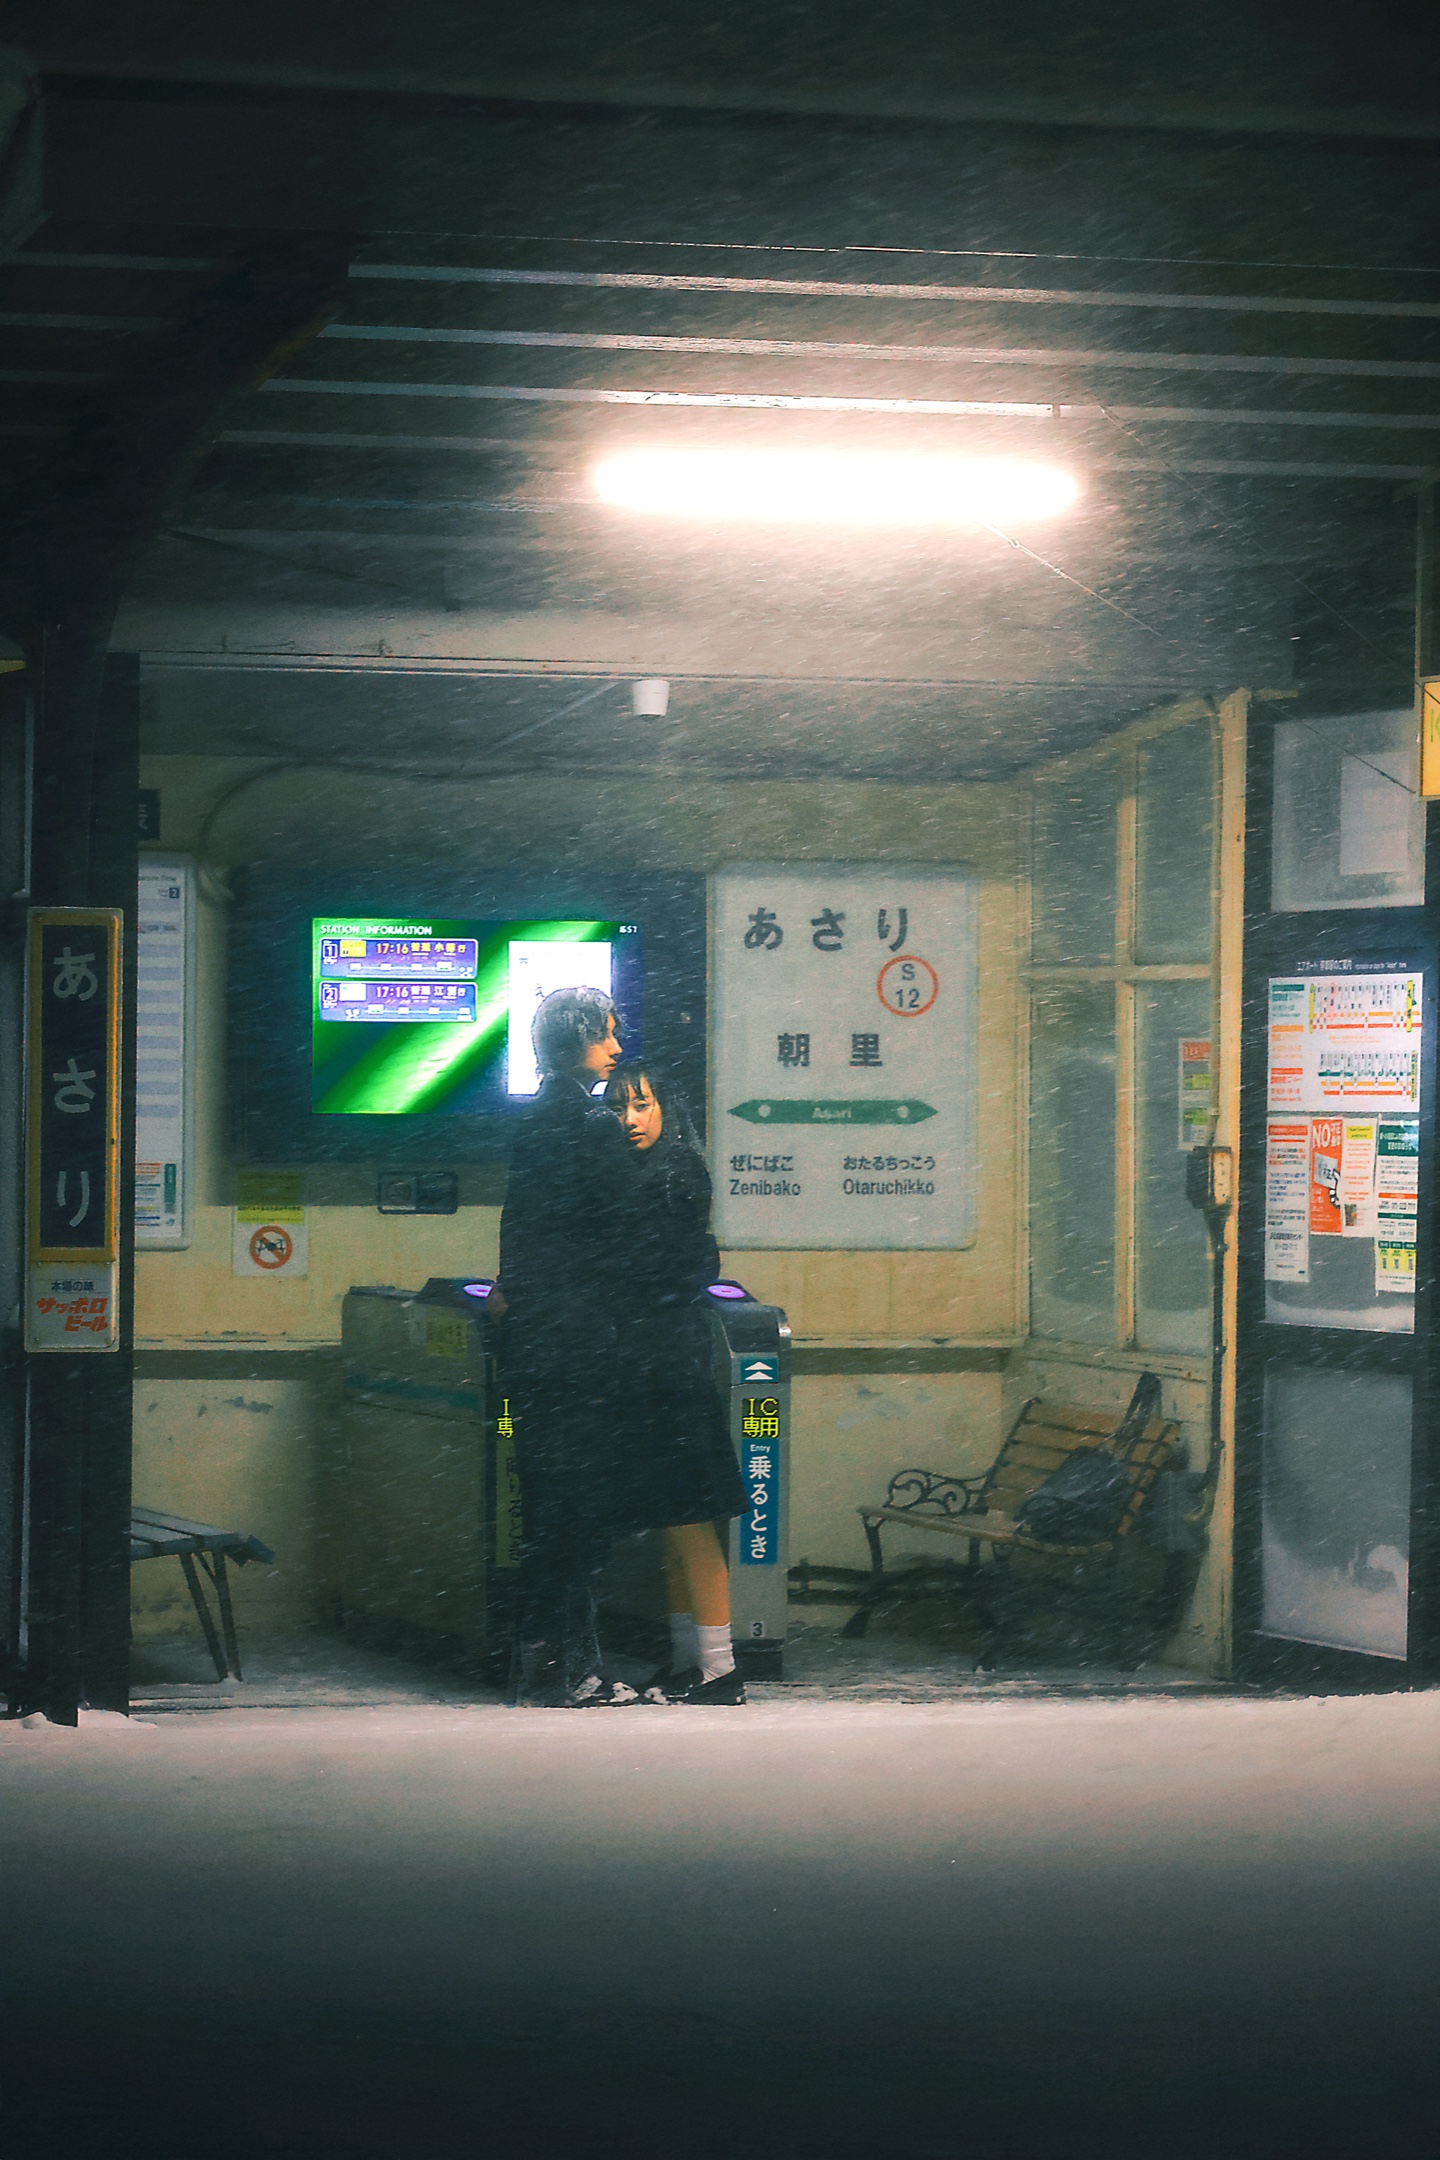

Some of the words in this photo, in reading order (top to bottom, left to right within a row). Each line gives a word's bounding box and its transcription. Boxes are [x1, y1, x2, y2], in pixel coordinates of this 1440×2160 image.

[320, 925, 360, 935] STATION
[365, 925, 432, 935] INFORMATION
[744, 906, 908, 952] あさり
[376, 943, 409, 955] 17:16
[901, 963, 916, 981] S
[376, 986, 409, 998] 17:16
[895, 988, 920, 1009] 12
[777, 1032, 883, 1068] 朝里
[53, 946, 98, 1228] あさり
[1312, 1123, 1331, 1148] NO
[730, 1154, 794, 1172] ぜにばこ
[843, 1155, 936, 1171] おたるちっこう
[729, 1178, 801, 1196] Zenibako
[843, 1178, 935, 1195] Otaruchikko
[36, 1297, 109, 1315] サッポロ
[64, 1315, 109, 1332] ビール
[748, 1398, 778, 1416] IC
[742, 1416, 779, 1438] 専用
[750, 1444, 771, 1453] Entry
[748, 1455, 772, 1559] 乗るとき
[752, 1622, 763, 1637] 3
